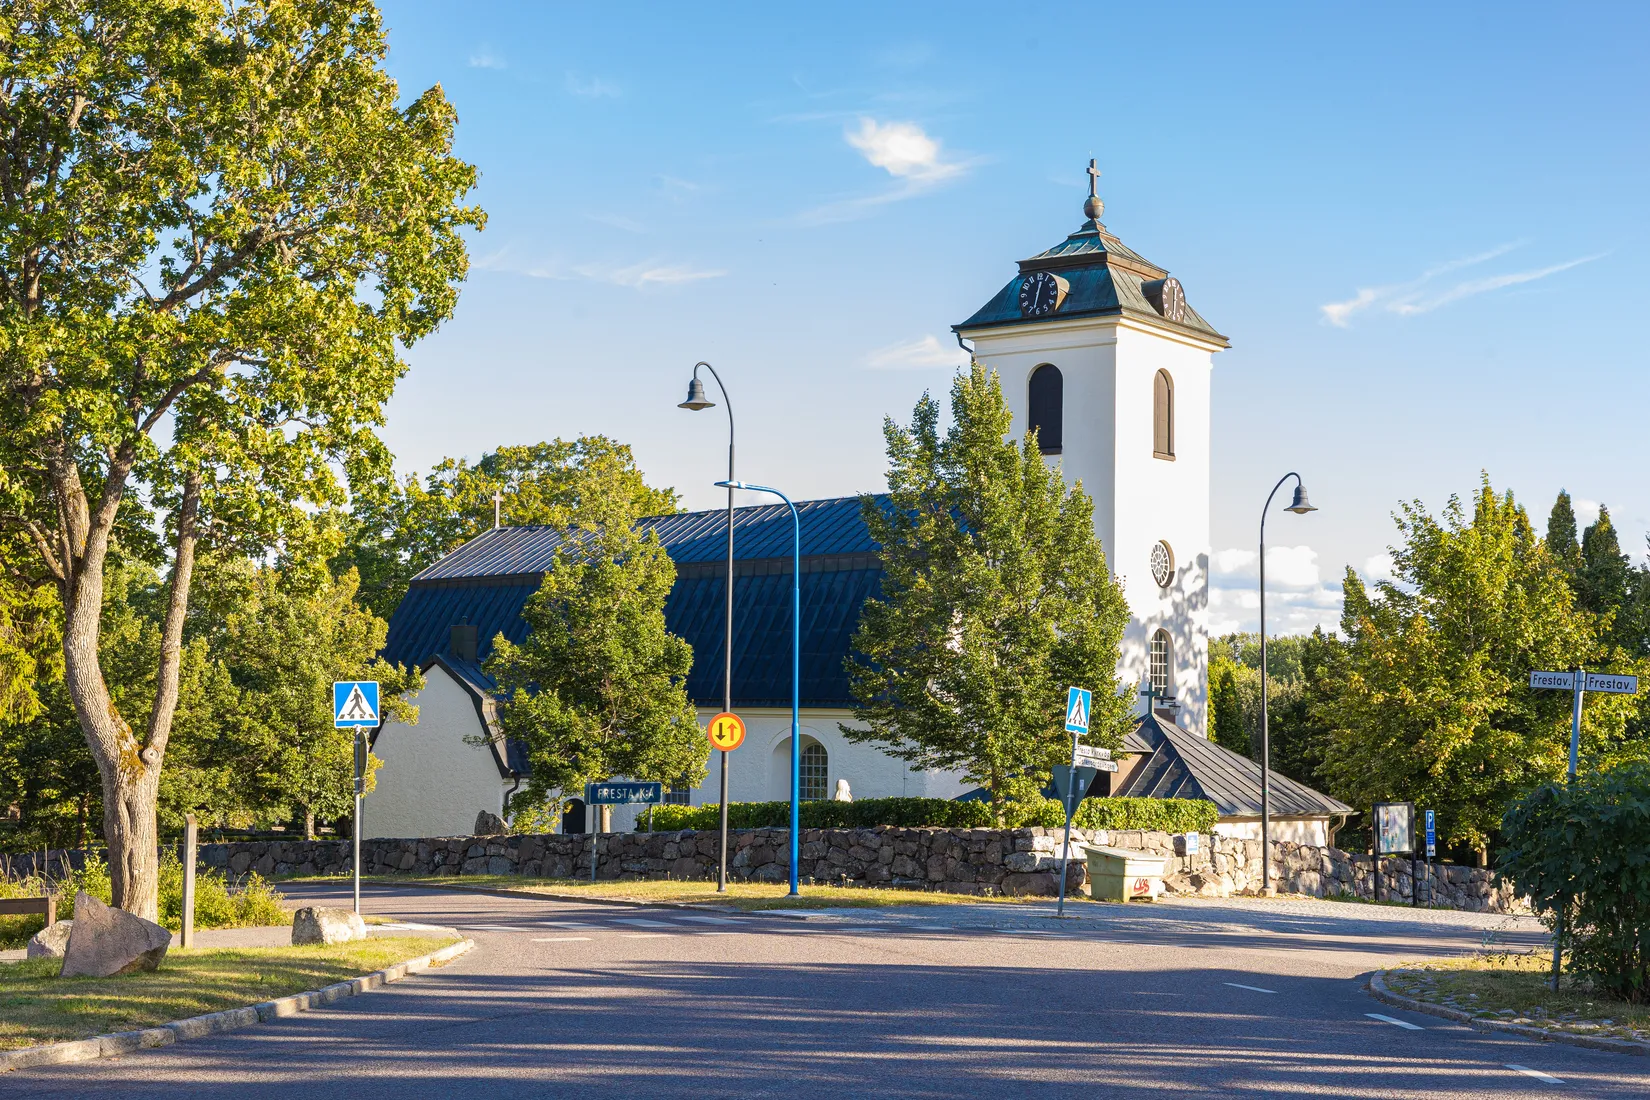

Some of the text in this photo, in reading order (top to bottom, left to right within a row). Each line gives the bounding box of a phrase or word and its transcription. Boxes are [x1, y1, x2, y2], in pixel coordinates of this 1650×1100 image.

[1532, 674, 1571, 686] Frestav.
[1589, 677, 1633, 690] Frestav.
[597, 788, 634, 799] FRESTA
[1428, 813, 1432, 828] P
